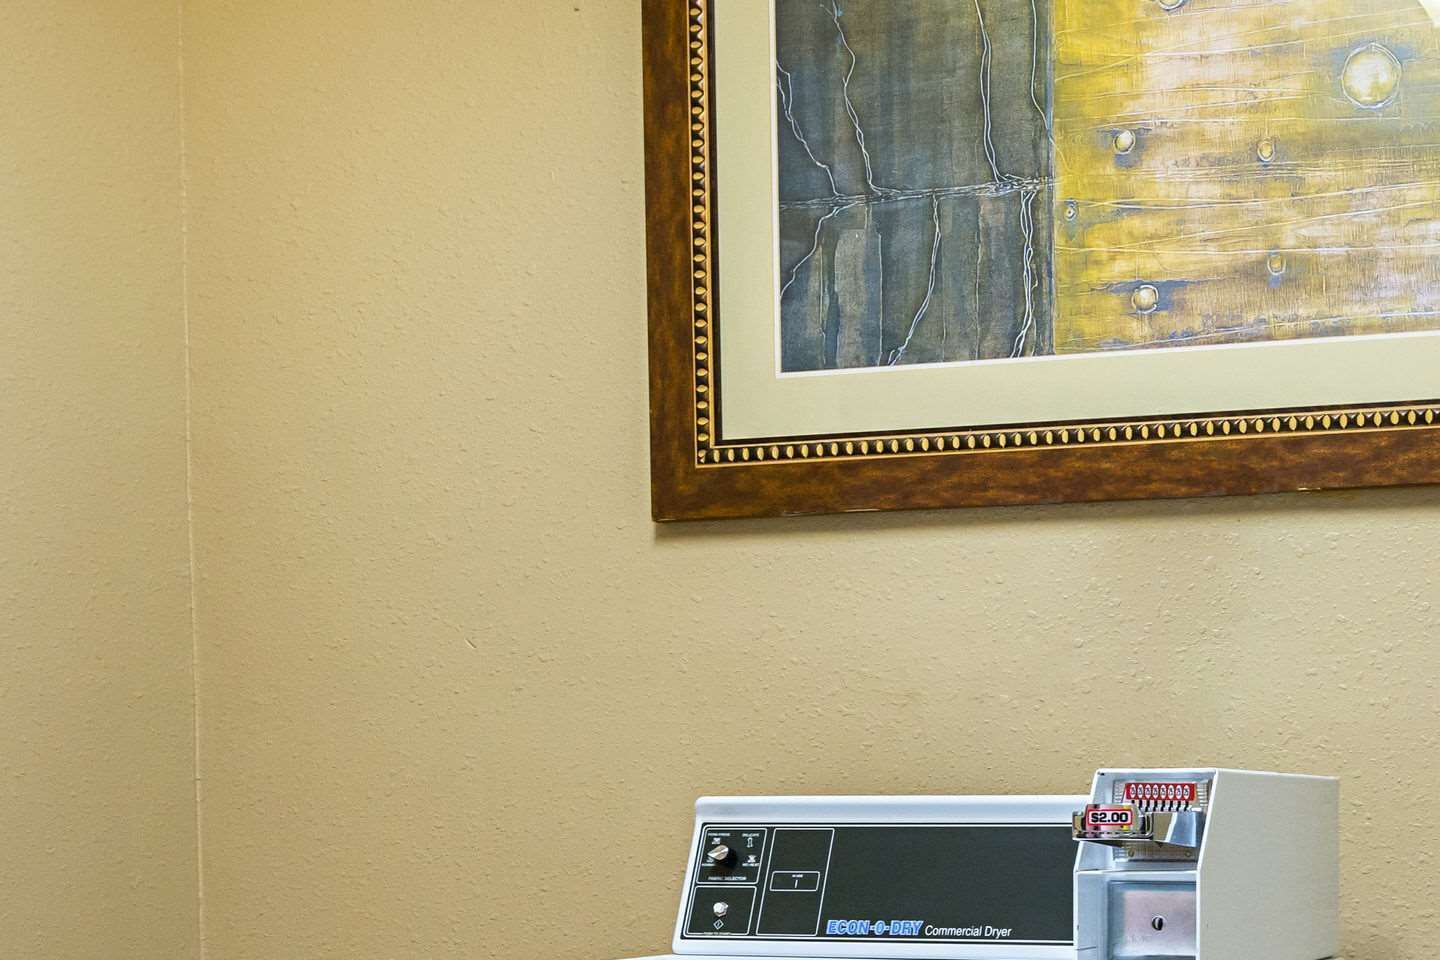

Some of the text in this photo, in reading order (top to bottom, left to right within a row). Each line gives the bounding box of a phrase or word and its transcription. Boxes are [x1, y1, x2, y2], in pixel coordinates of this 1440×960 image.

[1091, 812, 1129, 823] $2.00
[826, 919, 923, 936] ECON-O-DRY
[924, 925, 1012, 940] Commercial Dryer
